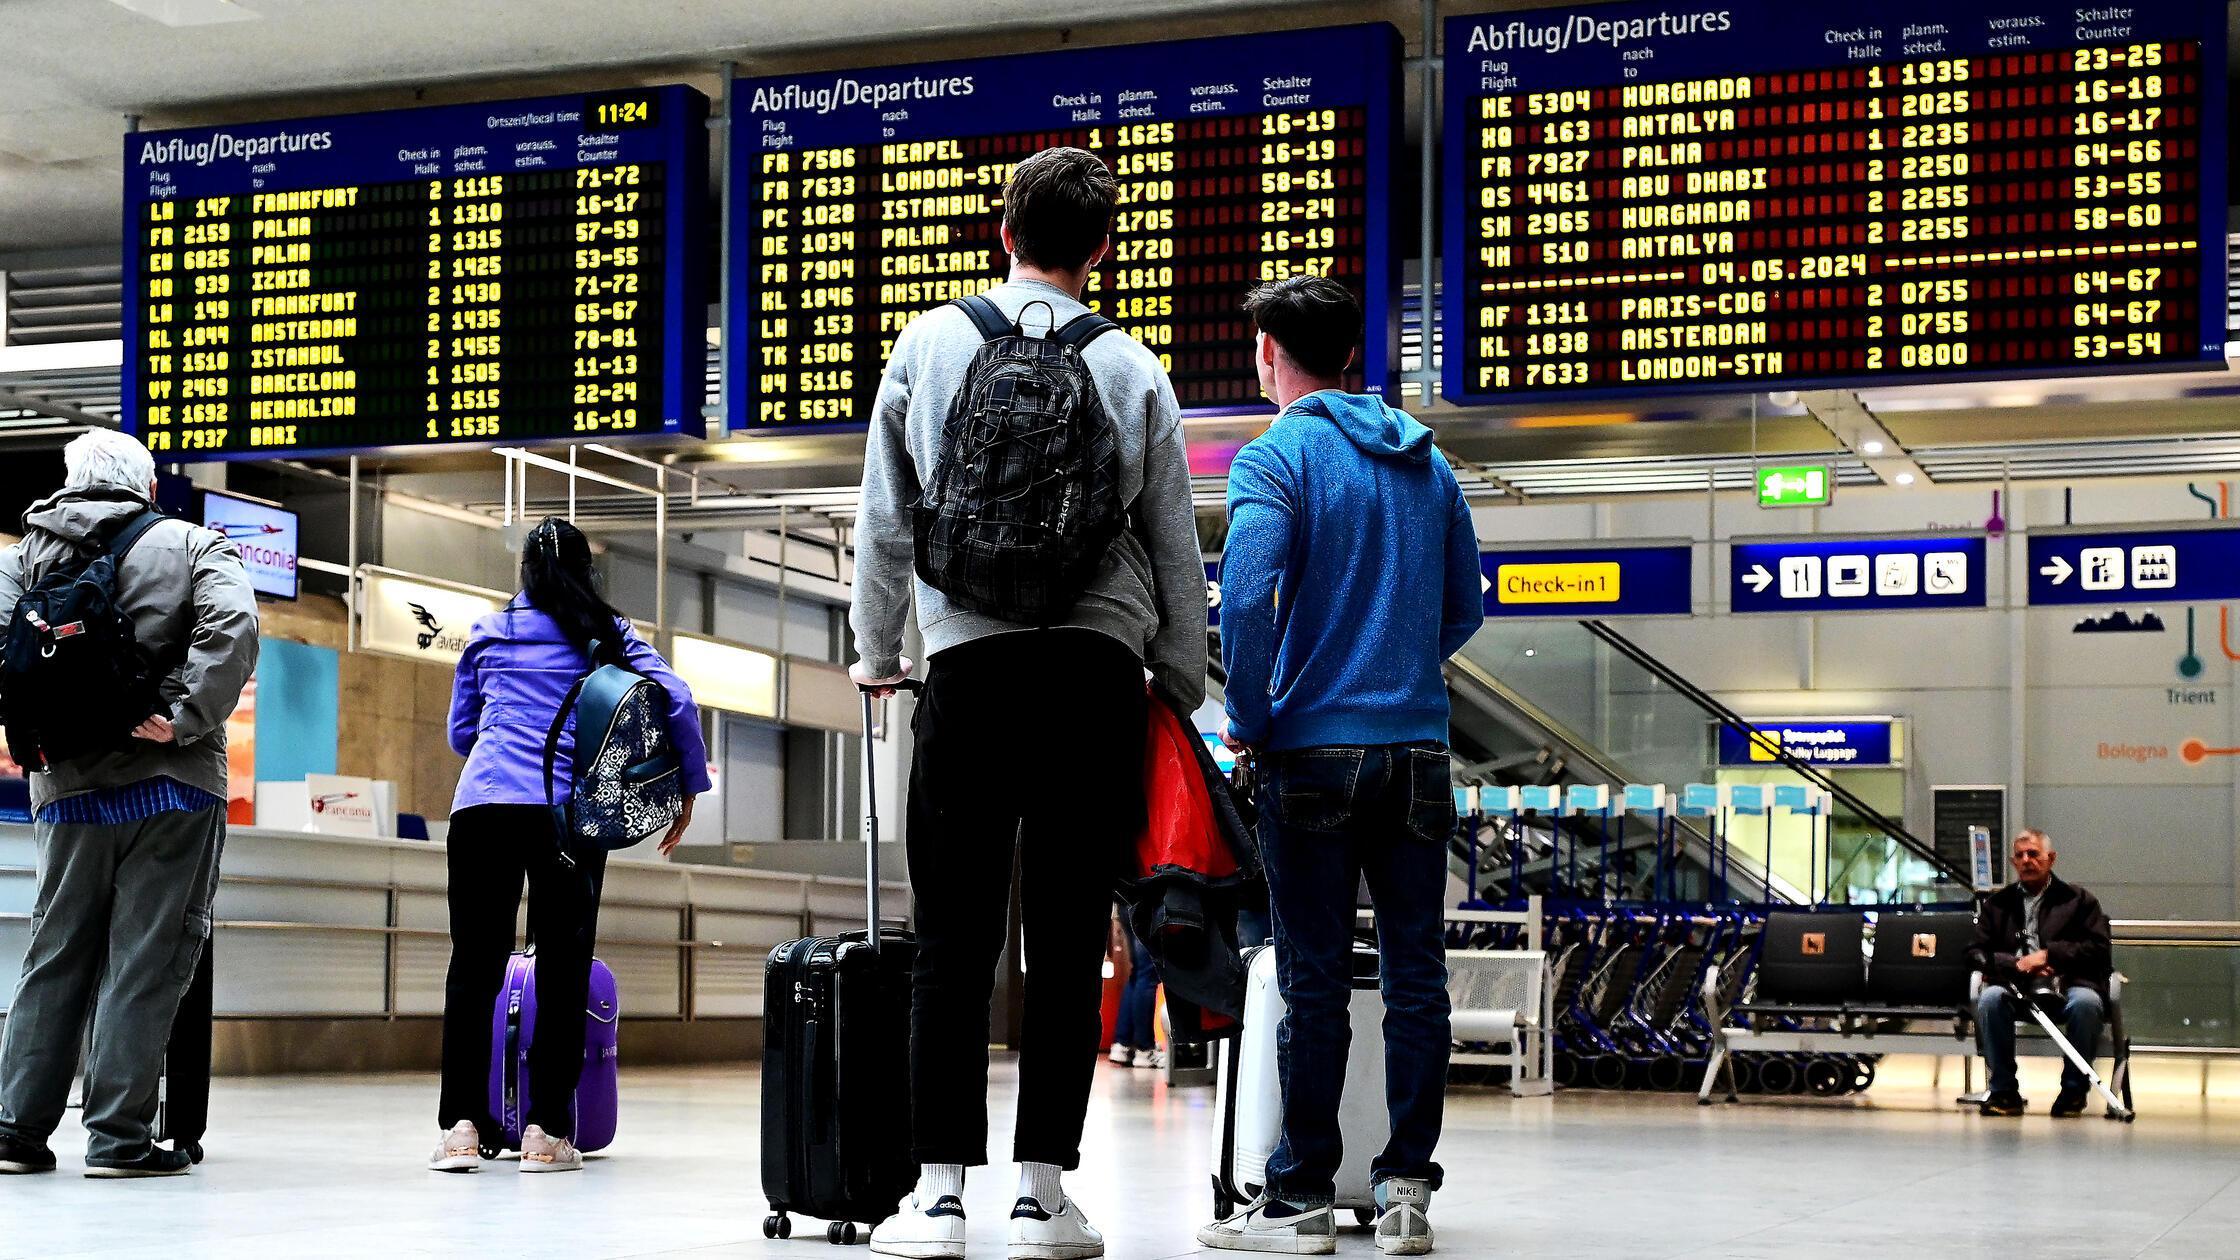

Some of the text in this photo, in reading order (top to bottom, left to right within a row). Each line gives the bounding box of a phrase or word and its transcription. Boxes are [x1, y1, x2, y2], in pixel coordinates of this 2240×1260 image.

[1989, 15, 2045, 30] vorauss.
[2076, 6, 2134, 23] Schalter
[1467, 10, 1731, 54] Abflug/Departures
[1825, 27, 1883, 44] Check in
[1902, 22, 1949, 39] planm.
[1988, 33, 2030, 48] estim.
[2076, 24, 2132, 41] Counter
[1623, 47, 1654, 61] nach
[1848, 44, 1882, 59] Halle
[1903, 40, 1946, 55] sched.
[1482, 60, 1508, 75] Flug
[1623, 66, 1637, 78] to
[1263, 76, 1311, 91] Schalter
[1482, 76, 1518, 92] Flight
[1529, 44, 2161, 114] 5304 HURGHADA 1935 23-25
[751, 76, 974, 114] Abflug/Departures
[1053, 92, 1101, 108] Check in
[1118, 88, 1157, 104] planm.
[1263, 92, 1310, 107] Counter
[598, 101, 647, 124] 11:24
[883, 109, 908, 122] nach
[1072, 108, 1101, 122] Halle
[1118, 105, 1155, 118] sched.
[1190, 100, 1225, 113] estim.
[1544, 76, 2161, 143] 163 ANTALYA 2025 16-18
[763, 120, 786, 133] Flug
[883, 126, 895, 138] to
[140, 131, 332, 166] Abflug/Departures
[577, 134, 619, 148] Schalter
[763, 134, 793, 149] Flight
[803, 110, 1335, 170] 7586 NEAPEL 1625 16-19
[1528, 108, 2161, 175] 7927 PALMA 2235 16-17
[577, 149, 618, 163] Counter
[803, 140, 1334, 198] 7633 1645 16-19
[1528, 140, 2161, 204] 4461 ABU DHABI 2250 64-66
[253, 165, 639, 213] FRANKFURT 1115 71-72
[802, 169, 1334, 225] 1028 1700 58-61
[1528, 172, 2161, 235] 2965 HURGHADA 2255 53-55
[253, 192, 639, 239] PALMA 1310 16-17
[802, 198, 1334, 253] 1034 PALMA 1705 22-24
[253, 220, 638, 265] PALMA 1315 57-59
[1544, 204, 2161, 264] 510 ANTALYA 2255 58-60
[802, 228, 1334, 281] 7904 CAGLIARI 1720 16-19
[252, 247, 638, 290] IZMIR 1425 53-55
[1703, 254, 1865, 284] 04.05.2024
[801, 257, 1334, 308] 1846 1810 65-67
[252, 274, 637, 316] FRANKFURT 1430 71-72
[1527, 268, 2160, 325] 1311 PARIS-CDG 0755 64-67
[252, 301, 637, 342] AMSTERDAM 1435 65-67
[814, 296, 1172, 335] 153 1825
[1527, 300, 2160, 355] 1838 AMSTERDAM 0755 64-67
[252, 328, 637, 368] ISTANBUL 1455 78-81
[801, 343, 853, 364] 1506
[1527, 333, 2160, 385] 7633 LONDON-STN 0800 53-54
[251, 355, 637, 394] BARCELONA 1505 11-13
[801, 371, 852, 391] 5116
[251, 382, 636, 420] HERAKLION 1515 22-24
[800, 398, 852, 419] 5634
[251, 409, 636, 445] BARI 1535 16-19
[237, 543, 295, 570] anconia
[1507, 574, 1606, 594] Check-in 1
[2167, 688, 2216, 704] Trient
[2096, 742, 2169, 761] Bologna
[1396, 1186, 1417, 1197] NIKE
